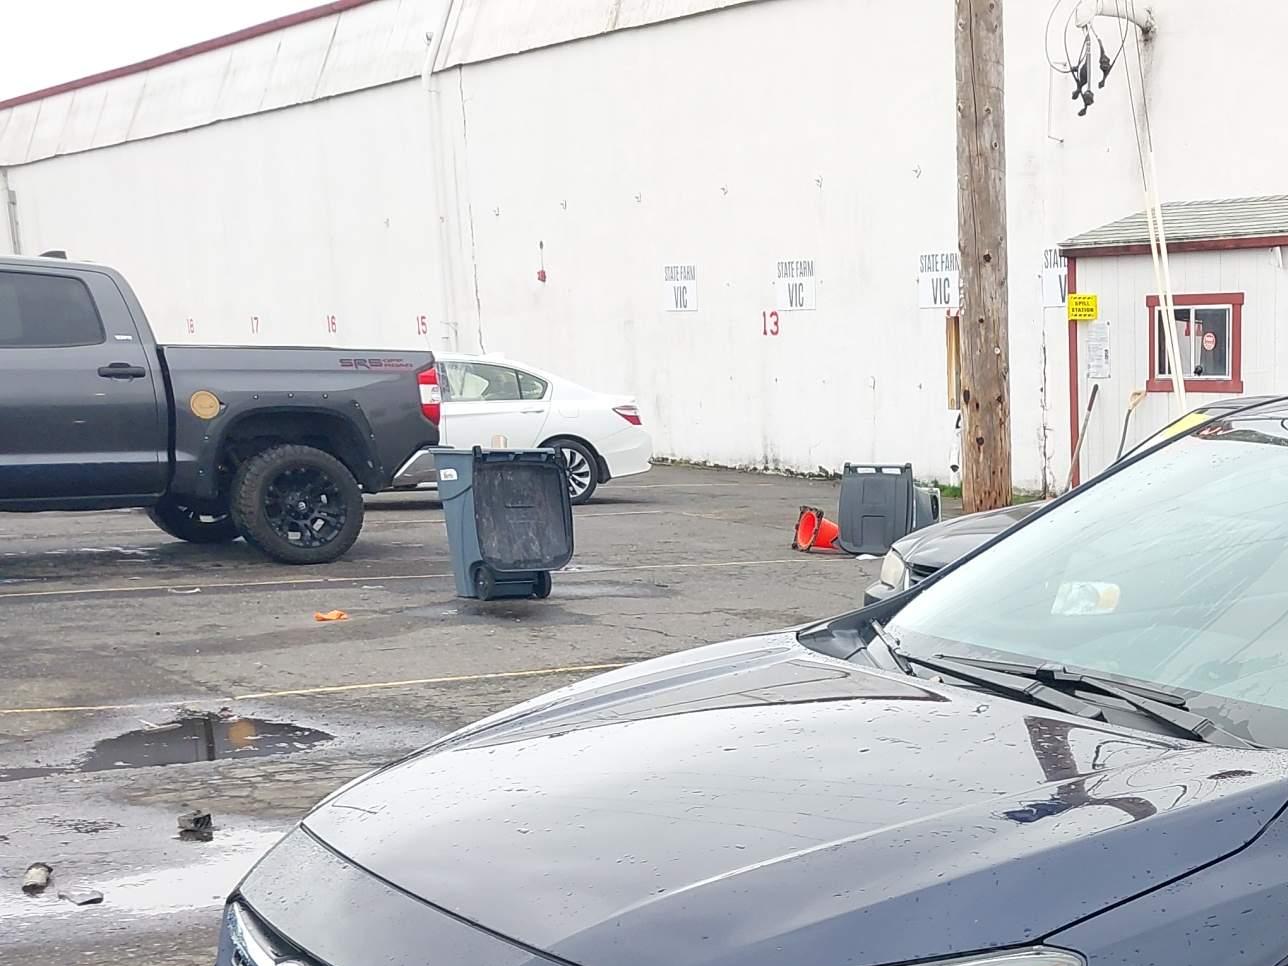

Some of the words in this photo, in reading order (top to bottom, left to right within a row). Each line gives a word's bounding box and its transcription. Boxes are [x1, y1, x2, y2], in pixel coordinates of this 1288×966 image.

[664, 266, 679, 282] STATE
[680, 265, 696, 281] FARM
[777, 261, 795, 279] STATE
[795, 260, 814, 278] FARM
[919, 254, 939, 273] STATE
[673, 286, 688, 309] VIC
[788, 283, 804, 308] VIC
[932, 277, 950, 305] VIC
[250, 316, 259, 334] 17
[416, 315, 428, 335] 15
[763, 311, 780, 336] 13
